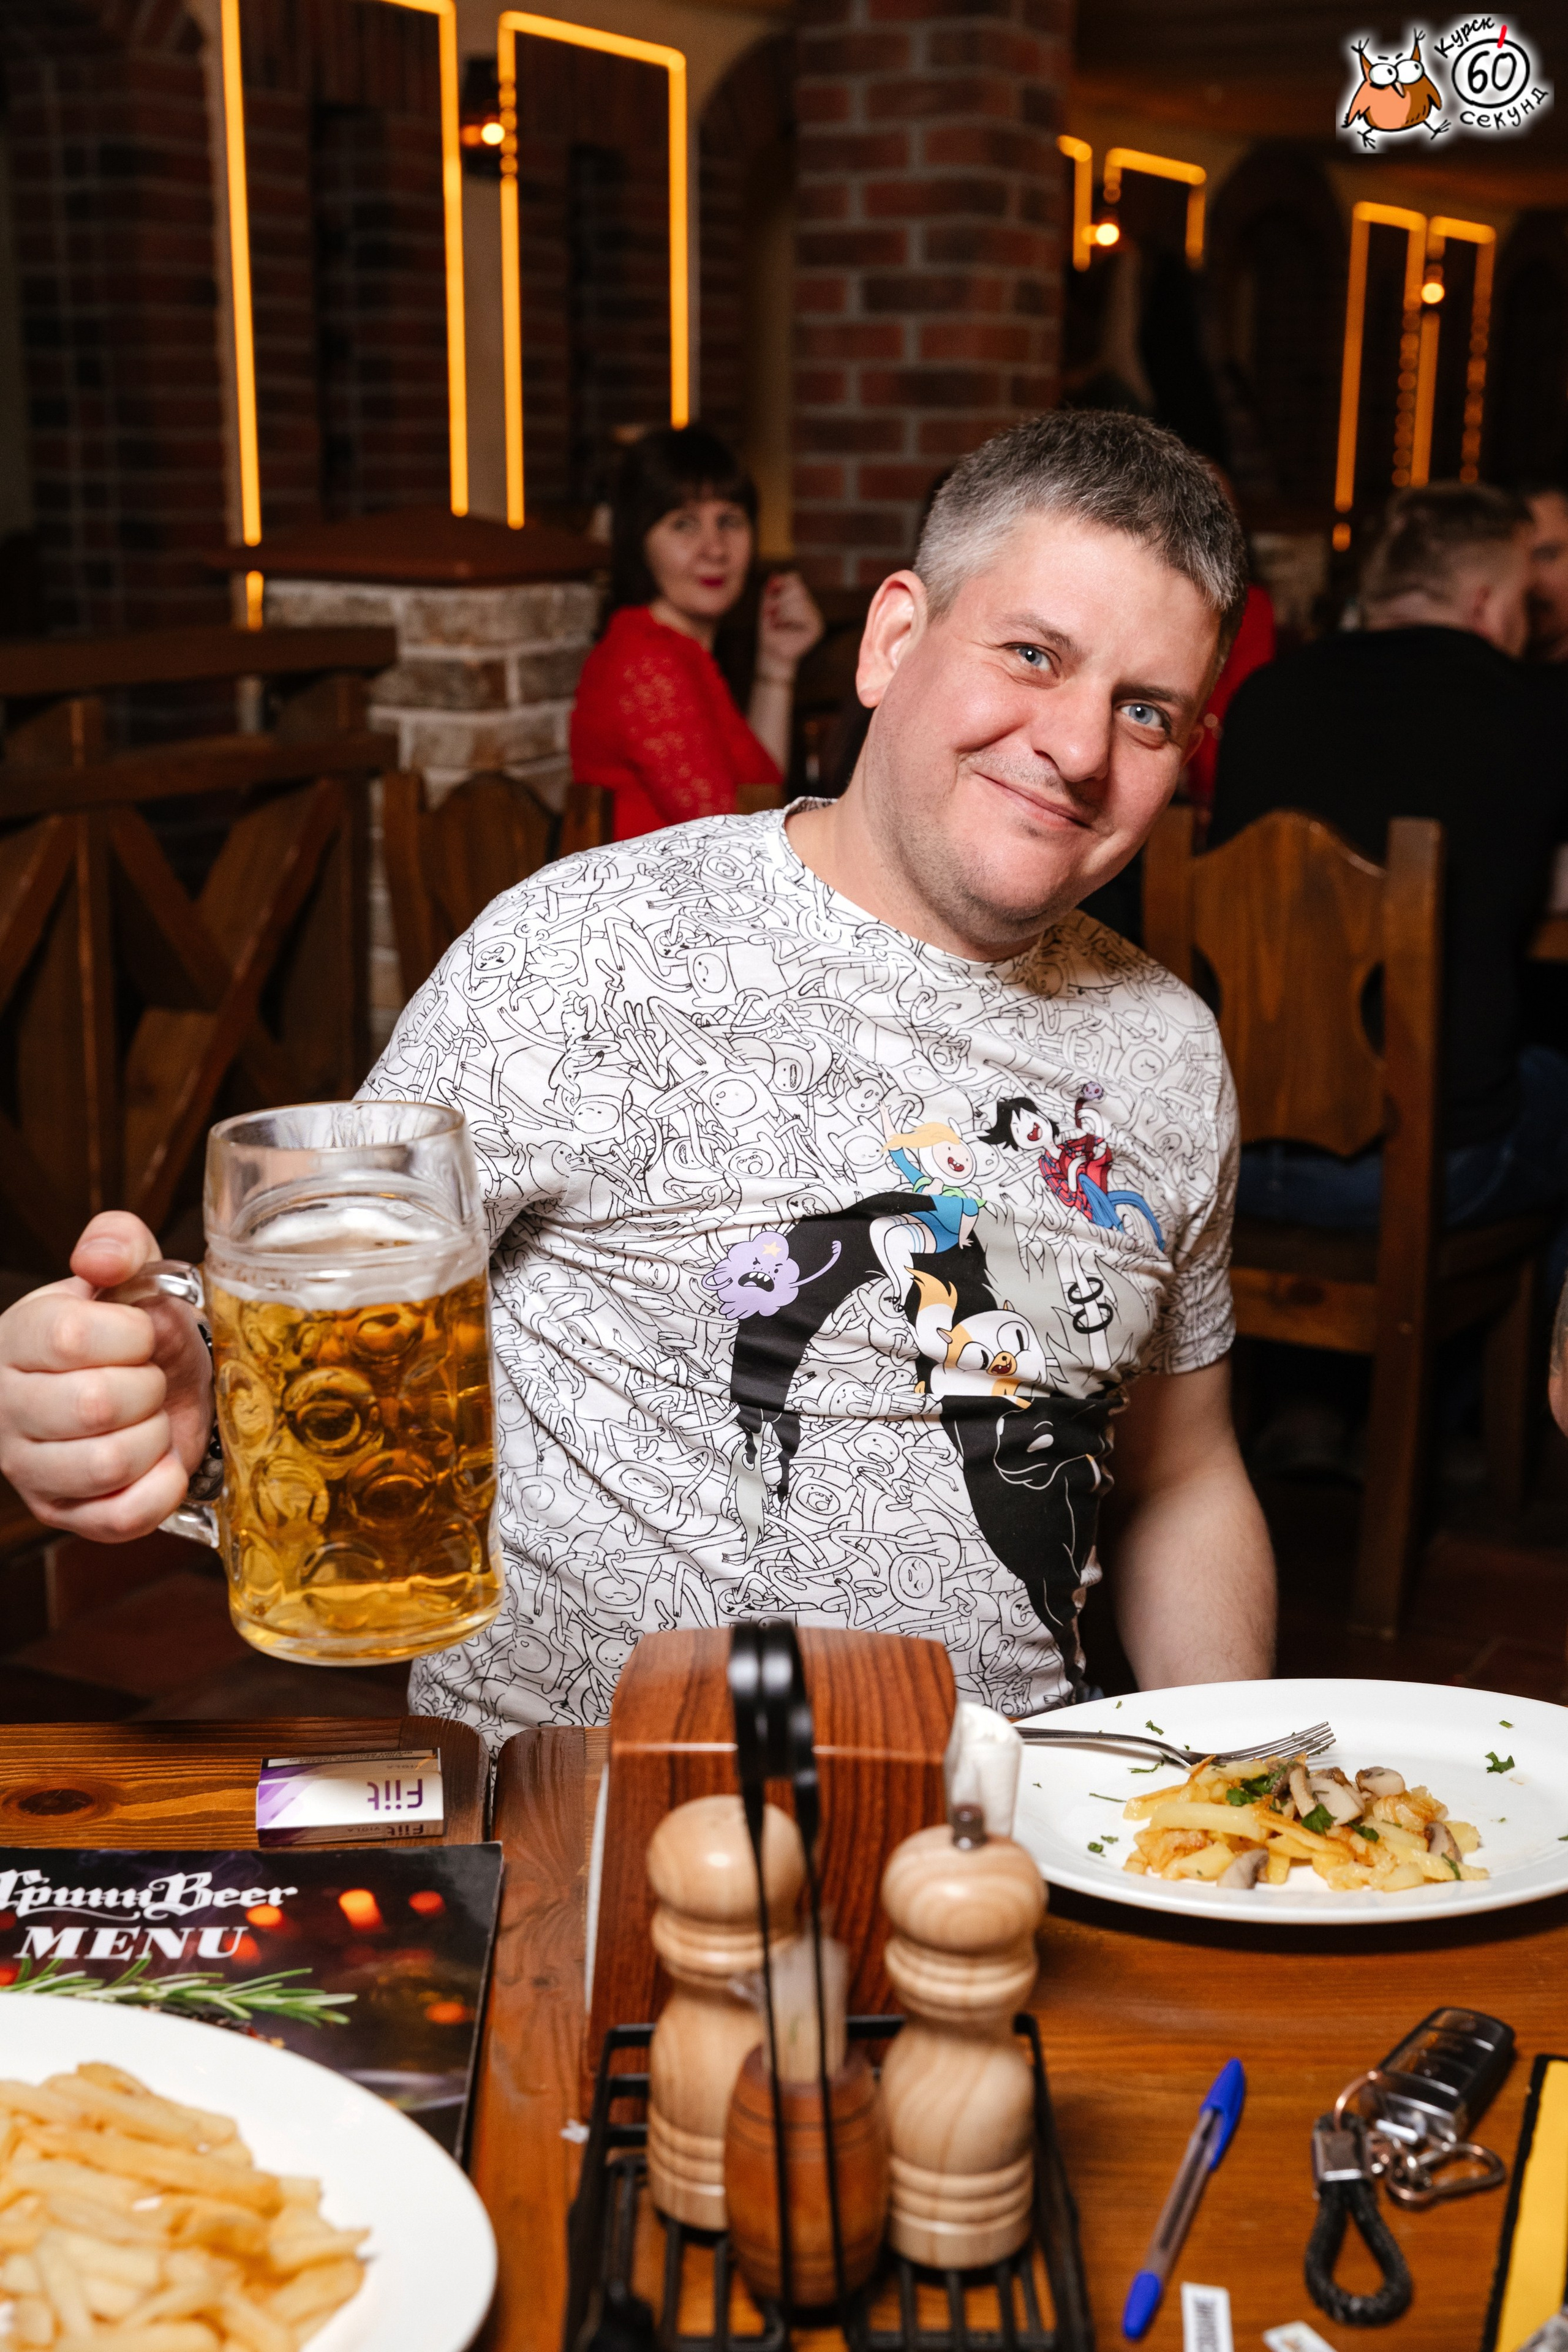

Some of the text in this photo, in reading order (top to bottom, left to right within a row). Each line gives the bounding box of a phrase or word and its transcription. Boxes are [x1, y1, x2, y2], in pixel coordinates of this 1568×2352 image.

[367, 1778, 423, 1811] Fiit
[386, 1824, 423, 1836] Fiit
[13, 1924, 249, 1961] MENU
